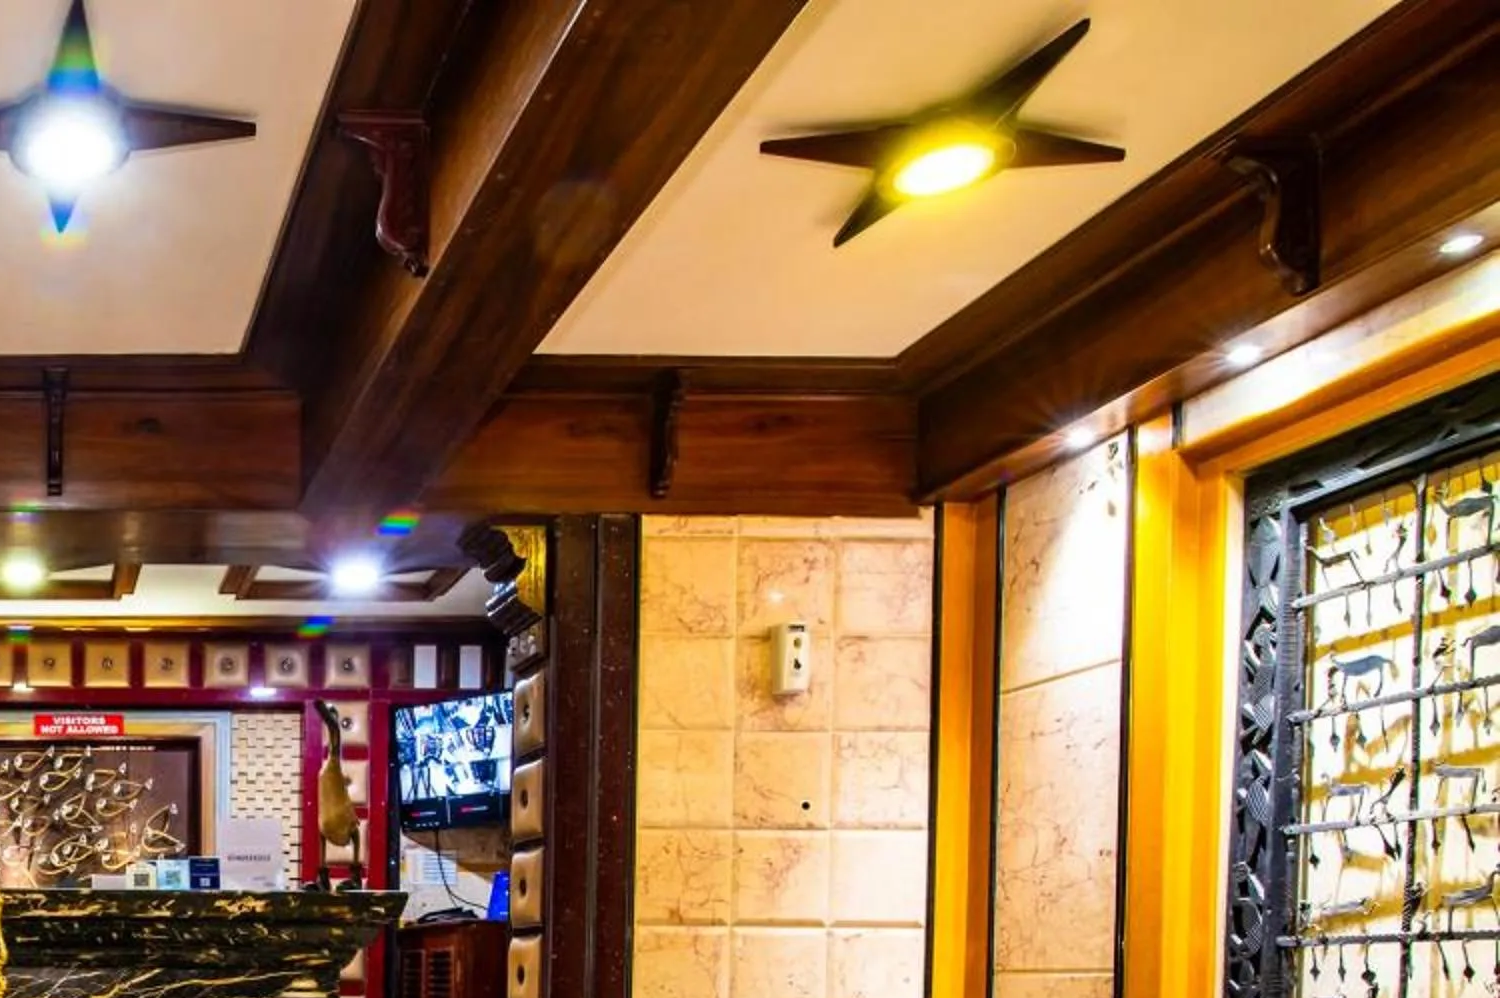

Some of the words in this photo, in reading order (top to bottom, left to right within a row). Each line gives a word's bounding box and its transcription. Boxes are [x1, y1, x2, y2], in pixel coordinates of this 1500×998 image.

[52, 716, 106, 725] VISITORS
[41, 725, 63, 734] NOT
[66, 725, 119, 735] ALLOWED
